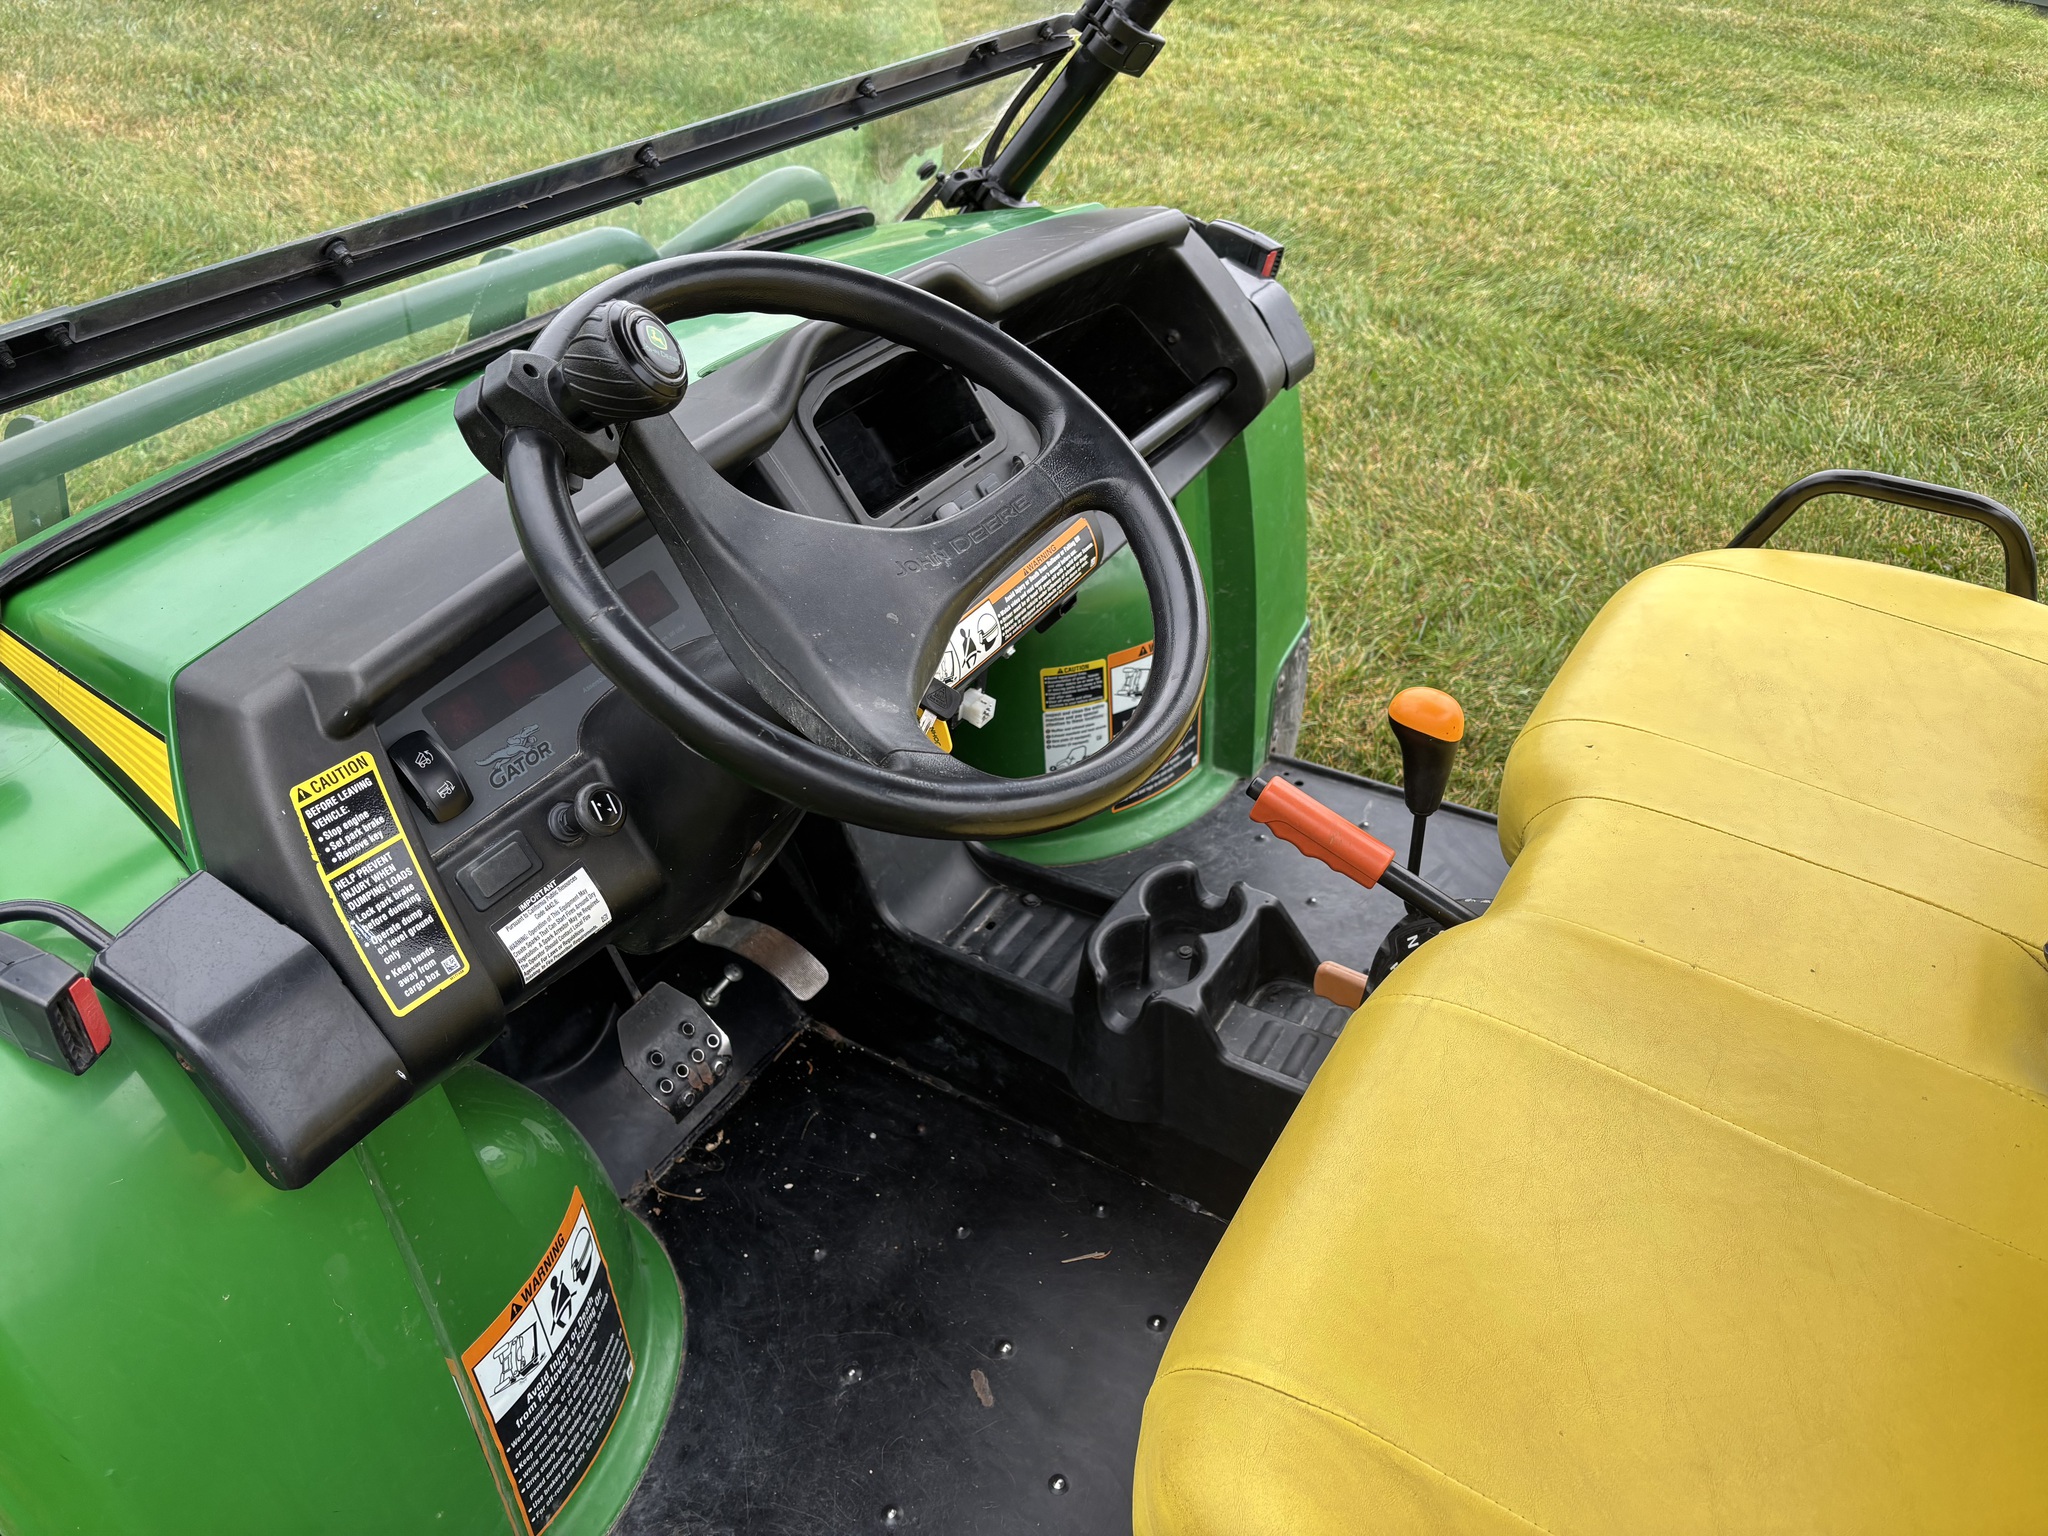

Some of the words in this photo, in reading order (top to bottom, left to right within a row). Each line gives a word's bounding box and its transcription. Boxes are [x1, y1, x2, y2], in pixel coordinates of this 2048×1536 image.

[895, 541, 950, 578] JOHN
[949, 494, 1032, 555] DEERE
[1026, 544, 1057, 571] WARNING
[1004, 590, 1016, 603] Avoid
[1013, 582, 1026, 595] Injury
[1028, 570, 1040, 583] Death
[1037, 564, 1048, 574] from
[1045, 553, 1061, 567] Rollover
[1062, 538, 1077, 553] Falling
[999, 604, 1011, 616] Watch
[1010, 597, 1021, 608] video
[1026, 584, 1035, 594] read
[1063, 663, 1089, 673] CAUTION
[310, 755, 369, 793] CAUTION
[489, 742, 551, 788] GATOR
[304, 795, 339, 819] BEFORE
[337, 777, 373, 801] LEAVING
[312, 805, 350, 829] VEHICLE:
[322, 825, 343, 840] Stop
[342, 810, 370, 830] engine
[329, 837, 345, 851] Set
[344, 827, 364, 844] park
[361, 815, 385, 833] brake
[335, 838, 369, 861] Remove
[367, 830, 384, 843] key
[334, 872, 356, 891] HELP
[356, 851, 392, 878] PREVENT
[340, 877, 371, 901] INJURY
[370, 863, 397, 883] WHEN
[347, 883, 387, 911] DUMPING
[385, 867, 413, 888] LOADS
[355, 906, 376, 923] Lock
[374, 895, 394, 912] park
[391, 883, 415, 900] brake
[361, 913, 388, 934] before
[387, 892, 422, 917] dumping
[505, 915, 525, 932] Pursuant
[527, 899, 547, 915] California
[544, 889, 559, 902] Public
[556, 875, 578, 892] Resources
[518, 879, 557, 912] IMPORTANT
[527, 919, 548, 937] Operation
[546, 914, 552, 923] of
[549, 909, 561, 919] This
[558, 893, 580, 913] Equipment
[577, 888, 588, 897] May
[533, 909, 546, 920] Code
[370, 922, 401, 945] Operate
[401, 908, 423, 926] dump
[376, 944, 389, 955] on
[387, 930, 408, 948] level
[407, 913, 434, 937] ground
[512, 945, 527, 958] Create
[525, 935, 541, 949] Sparks
[538, 927, 550, 938] That
[547, 921, 557, 931] Can
[555, 914, 567, 925] Start
[564, 907, 576, 917] Fires
[574, 896, 590, 910] Around
[587, 891, 597, 900] Dry
[516, 946, 539, 964] Vegetation.
[541, 933, 554, 946] Spark
[568, 915, 578, 924] May
[581, 898, 600, 914] Required.
[520, 962, 529, 971] The
[527, 949, 545, 965] Operator
[544, 938, 559, 952] Should
[557, 927, 574, 942] Contact
[571, 918, 584, 931] Local
[582, 913, 591, 923] Fire
[383, 949, 401, 965] only
[390, 961, 412, 978] Keep
[410, 946, 435, 965] hands
[397, 970, 419, 988] away
[417, 958, 437, 974] from
[523, 961, 541, 976] Agencies
[540, 955, 548, 964] For
[547, 947, 559, 959] Laws
[557, 943, 563, 951] or
[561, 927, 585, 946] Regulations
[403, 979, 426, 997] cargo
[424, 969, 441, 983] box
[520, 1233, 567, 1302] WARNING
[515, 1395, 537, 1428] from
[537, 1355, 569, 1402] Rollover
[569, 1342, 577, 1357] or
[574, 1306, 596, 1344] Falling
[594, 1288, 603, 1307] Off
[526, 1370, 550, 1404] Avoid
[549, 1339, 570, 1373] Injury
[570, 1326, 578, 1341] or
[577, 1296, 595, 1328] Death
[510, 1428, 527, 1448] Wear
[526, 1402, 549, 1431] helmets
[547, 1384, 562, 1404] when
[560, 1361, 577, 1386] driving
[514, 1448, 522, 1459] or
[521, 1425, 543, 1451] uneven
[541, 1403, 561, 1427] terrain,
[560, 1392, 566, 1402] or
[565, 1383, 572, 1394] at
[570, 1363, 584, 1386] higher
[518, 1450, 534, 1470] Keep
[533, 1433, 548, 1452] arms
[547, 1418, 558, 1435] and
[556, 1405, 568, 1422] legs
[567, 1397, 574, 1407] in
[572, 1376, 587, 1399] during
[522, 1458, 539, 1479] While
[539, 1434, 560, 1460] turning,
[559, 1414, 572, 1434] drive
[570, 1398, 582, 1416] slow
[581, 1384, 590, 1400] and
[588, 1376, 595, 1387] do
[593, 1364, 601, 1378] not
[525, 1471, 540, 1490] Drive
[539, 1451, 556, 1473] slowly
[555, 1434, 568, 1453] when
[582, 1402, 589, 1413] on
[587, 1385, 598, 1405] rough
[529, 1477, 546, 1501] paved
[545, 1451, 568, 1480] surfaces,
[567, 1431, 580, 1450] while
[579, 1401, 598, 1433] operating
[532, 1494, 544, 1509] Use
[543, 1472, 562, 1496] brakes
[560, 1453, 575, 1475] going
[574, 1435, 587, 1455] down
[535, 1504, 546, 1519] For
[545, 1478, 567, 1507] off-road
[565, 1466, 575, 1481] use
